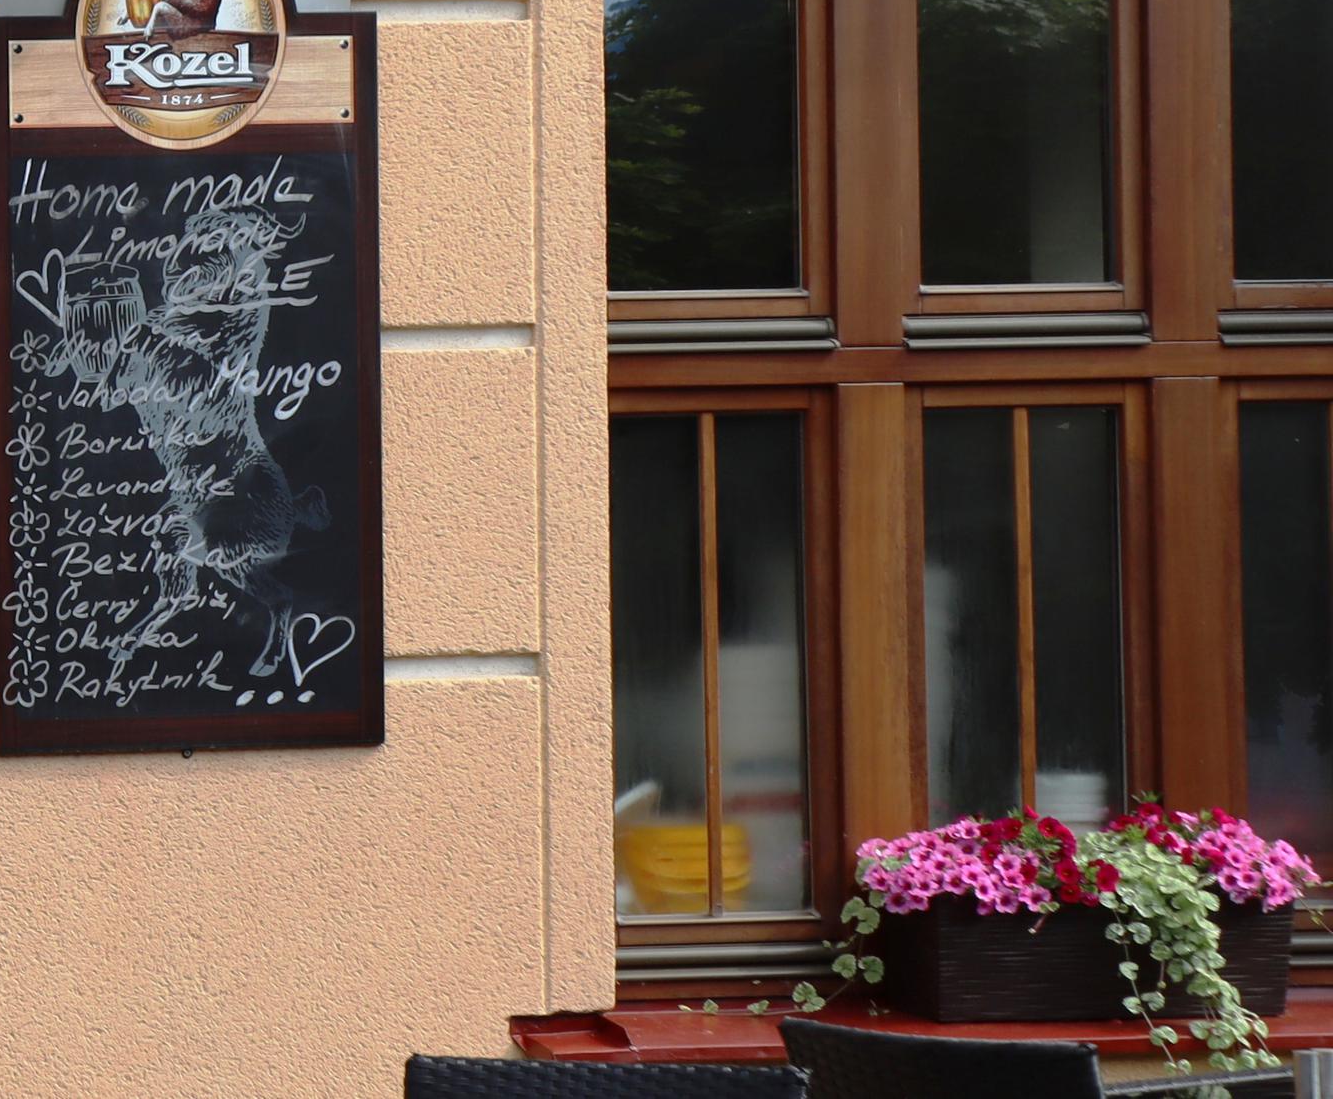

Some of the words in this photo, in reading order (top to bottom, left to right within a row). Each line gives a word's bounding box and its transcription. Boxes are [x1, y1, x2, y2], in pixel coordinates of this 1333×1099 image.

[104, 42, 254, 88] Kozel
[161, 94, 204, 106] 1874
[9, 158, 140, 224] Home
[162, 155, 313, 215] made
[55, 580, 150, 624] Černý
[55, 620, 198, 652] Okurka
[55, 650, 233, 707] Rakytník
